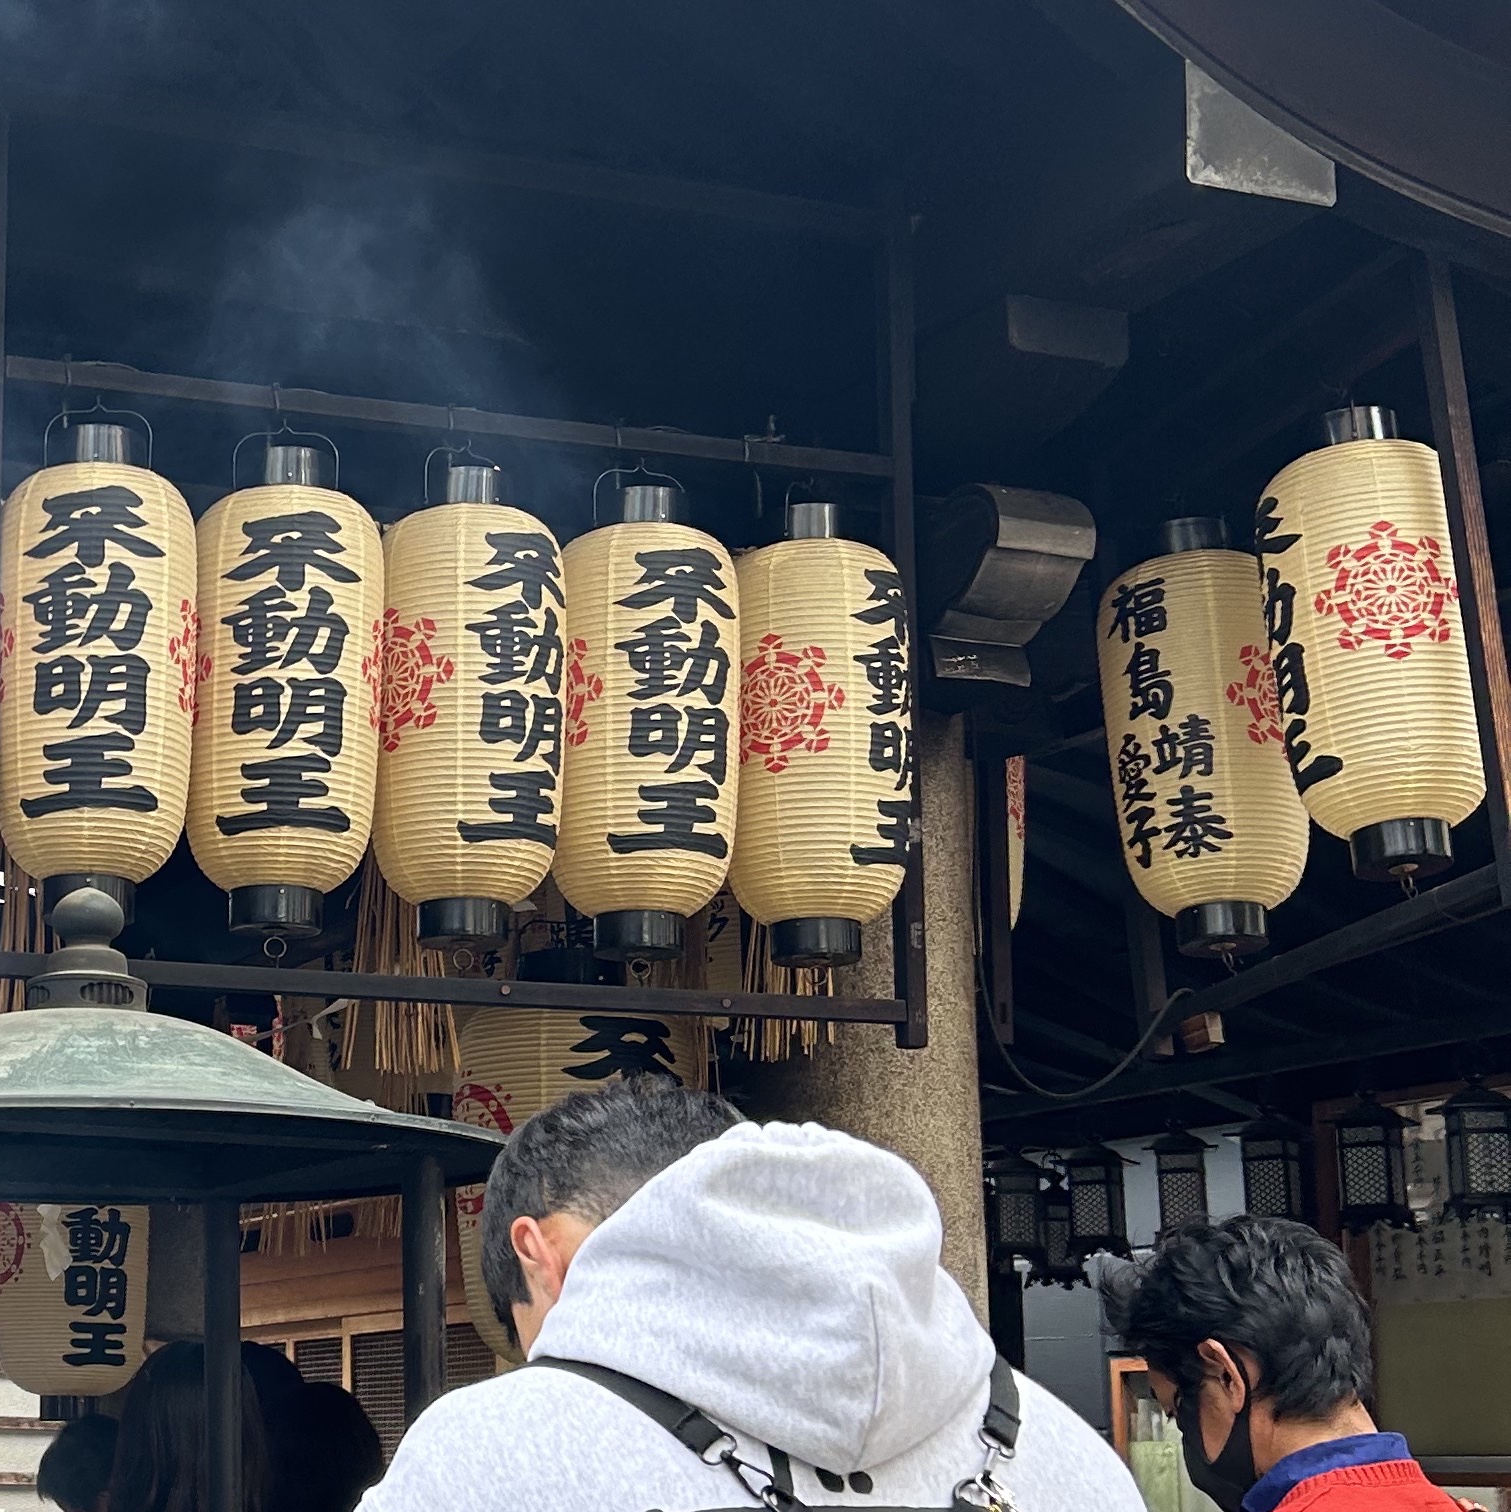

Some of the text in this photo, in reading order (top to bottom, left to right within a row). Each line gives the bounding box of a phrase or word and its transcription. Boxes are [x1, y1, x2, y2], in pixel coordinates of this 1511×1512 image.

[21, 485, 165, 818] 不動明王
[215, 511, 362, 837] 不動明王
[457, 532, 567, 851] 不動明王
[607, 548, 736, 860] 不動明王
[1109, 577, 1174, 721] 福島
[1117, 733, 1164, 869] 愛子
[1152, 714, 1234, 859] 靖泰
